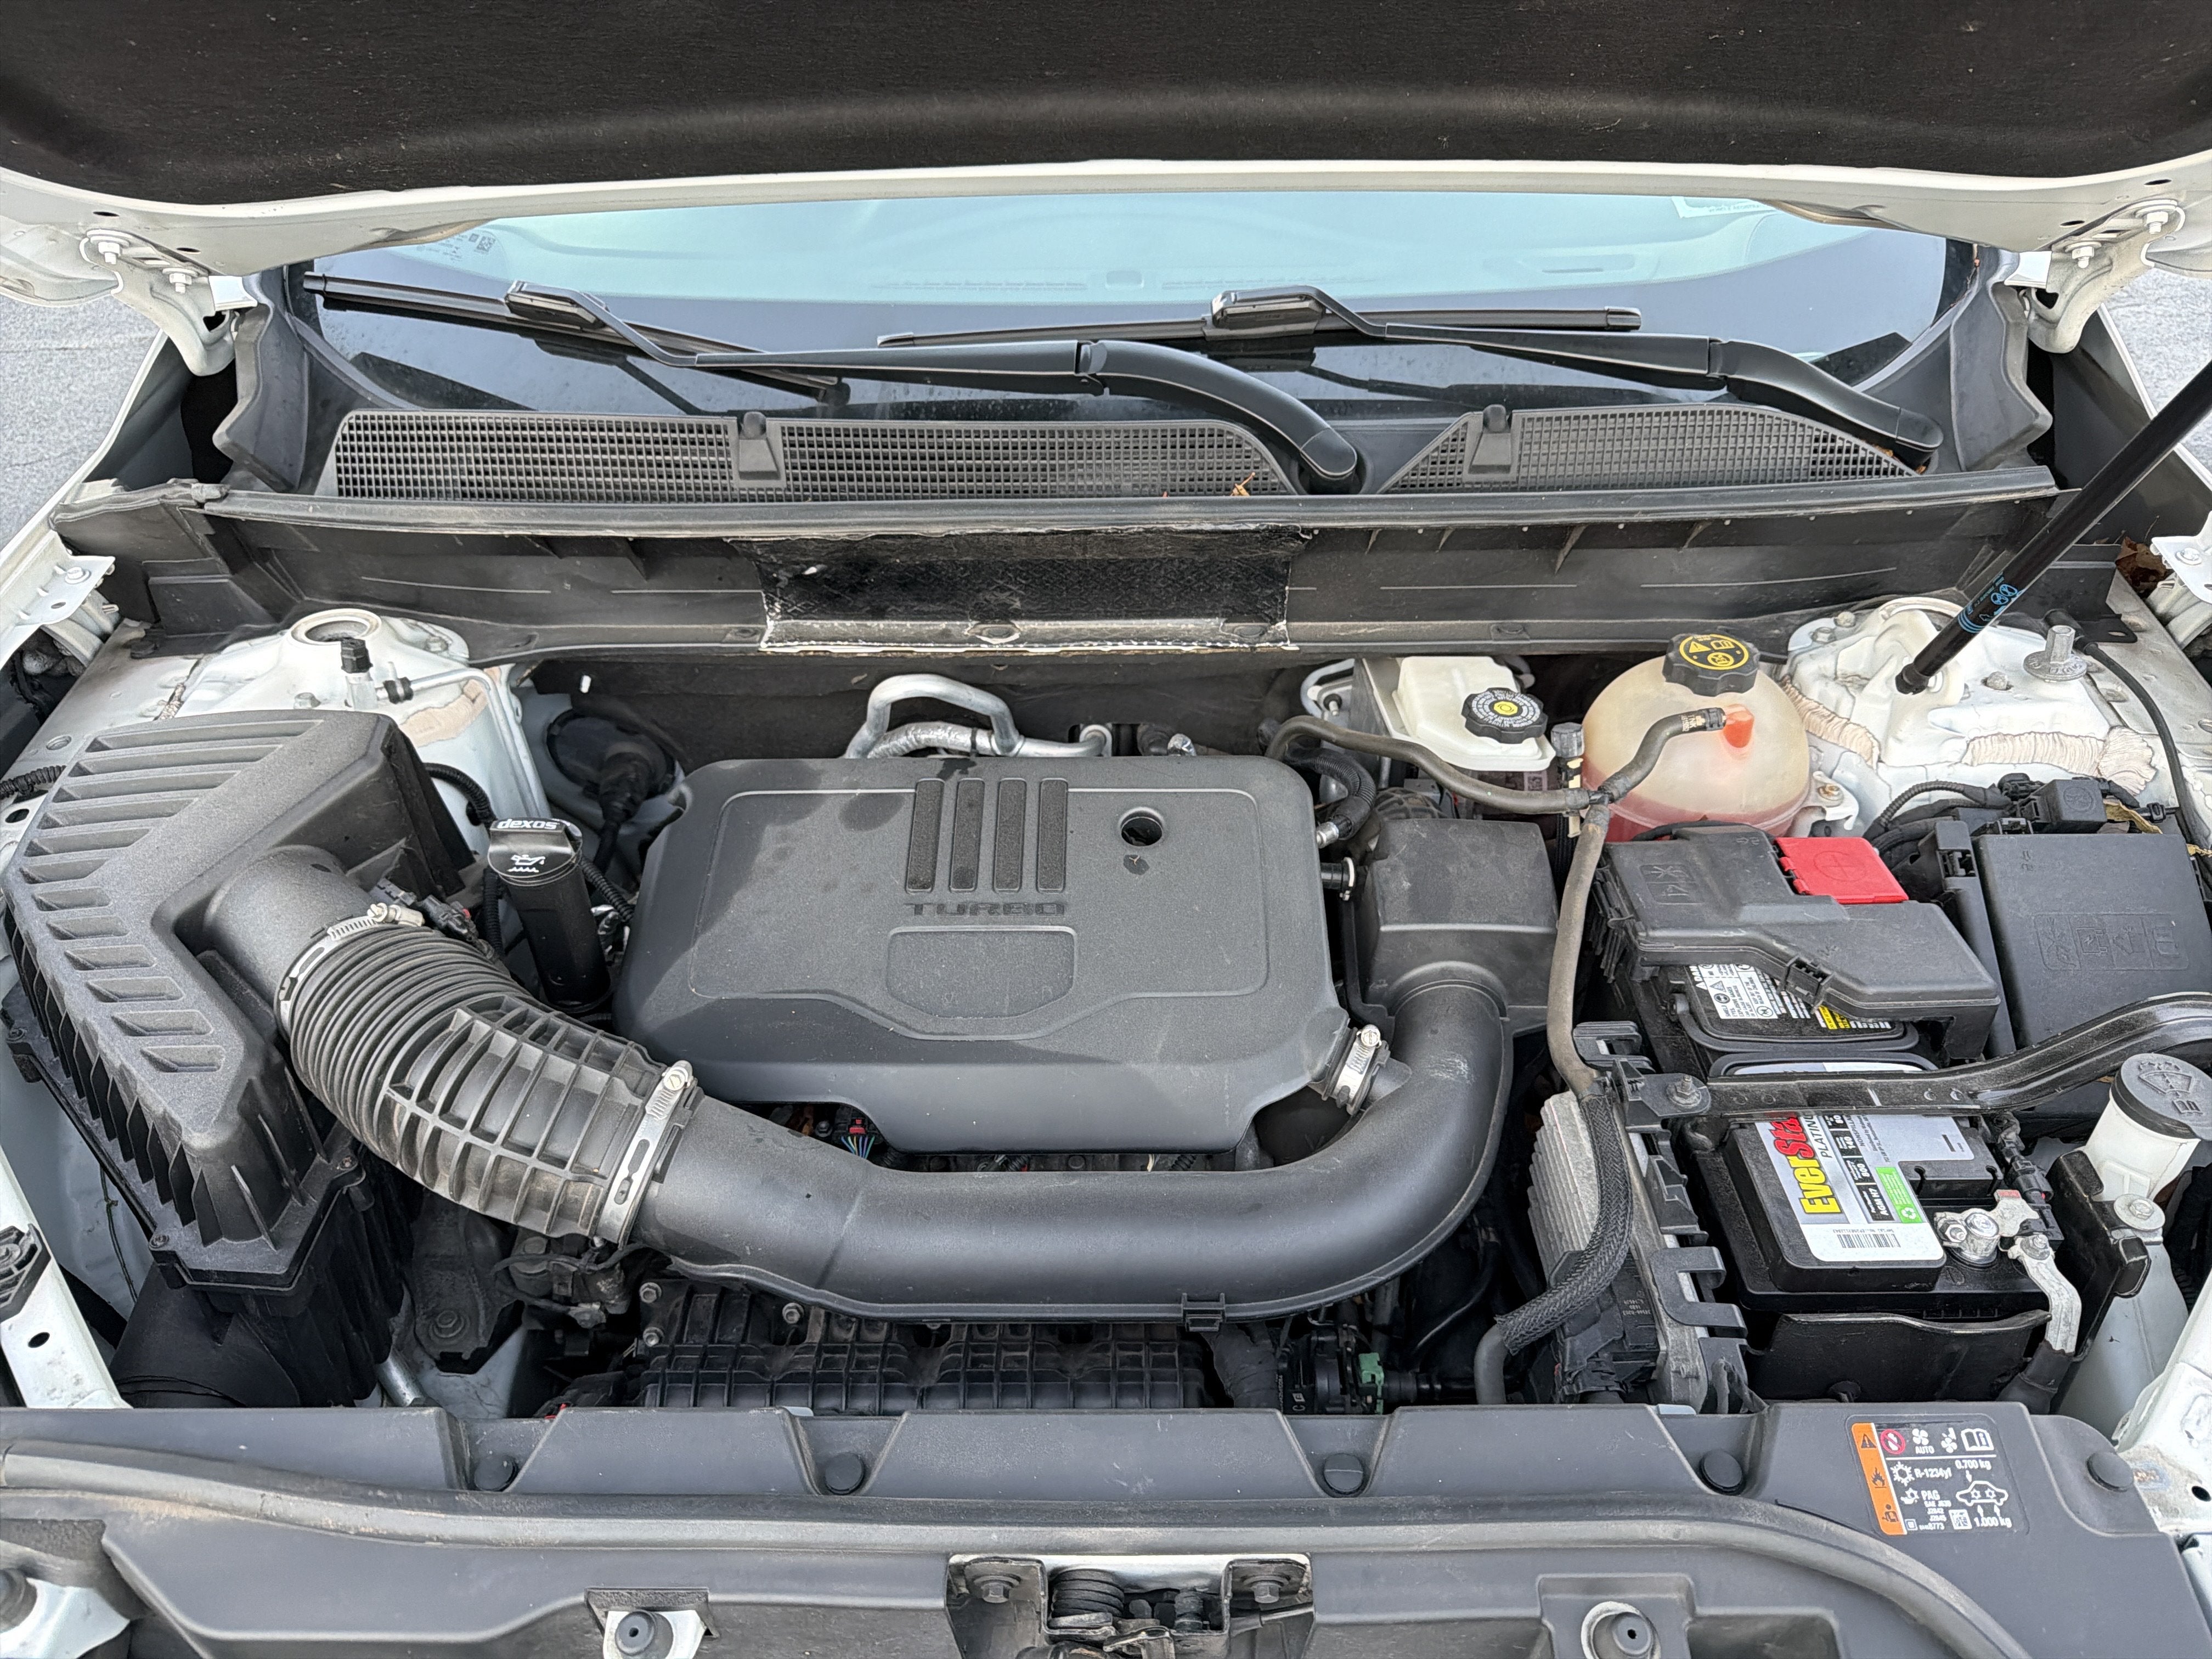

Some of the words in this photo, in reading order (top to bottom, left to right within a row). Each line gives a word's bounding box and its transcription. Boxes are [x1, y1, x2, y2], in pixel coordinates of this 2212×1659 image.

[497, 819, 558, 830] dexos
[904, 902, 1065, 916] TURBO
[1833, 1115, 1844, 1124] 80
[1844, 1136, 1857, 1149] 140
[1857, 1163, 1871, 1178] 800
[1867, 1188, 1879, 1197] H7
[1873, 1198, 1889, 1215] AGM
[1915, 1446, 1935, 1454] AUTO
[1955, 1459, 1979, 1469] 0.700
[1979, 1459, 1991, 1470] kg
[1914, 1468, 1953, 1480] R-1234yf
[1921, 1489, 1940, 1500] PAG
[1973, 1516, 1999, 1527] 1.000
[1999, 1516, 2012, 1528] kg
